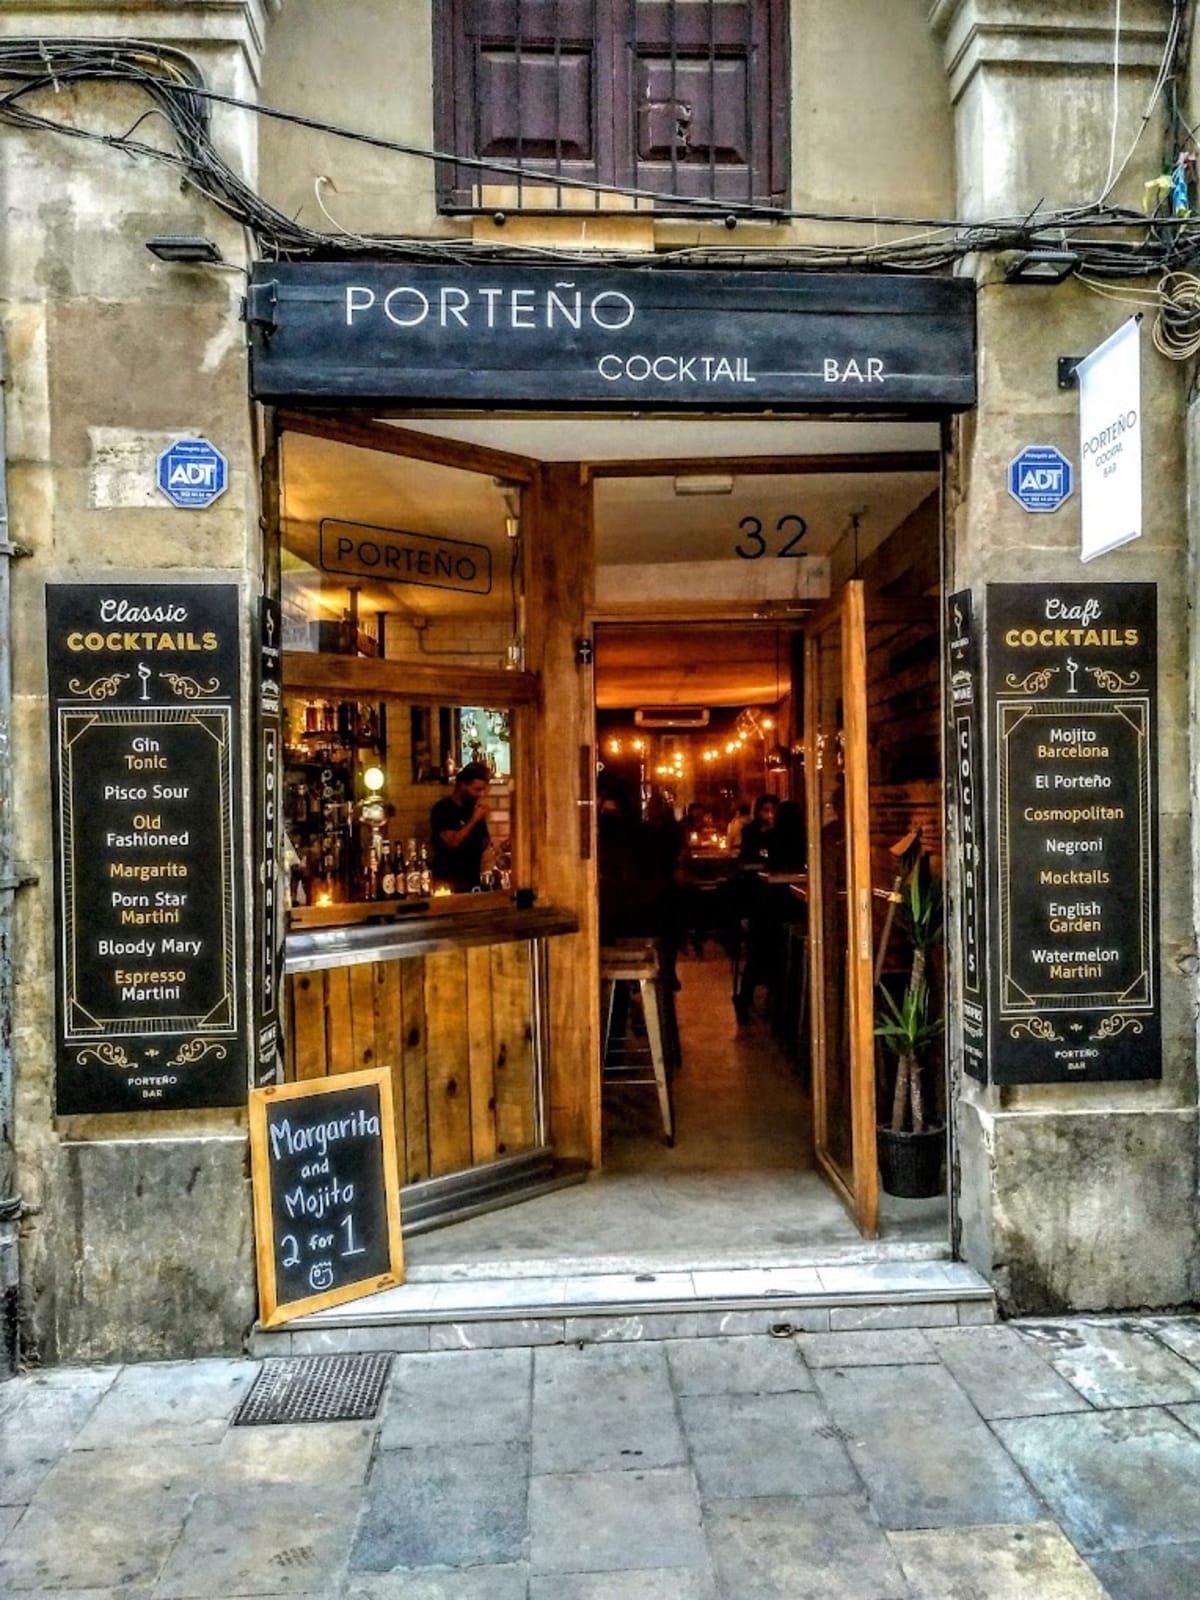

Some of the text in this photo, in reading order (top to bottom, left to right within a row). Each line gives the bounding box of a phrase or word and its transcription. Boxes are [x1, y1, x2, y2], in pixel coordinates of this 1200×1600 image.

[345, 281, 635, 330] PORTEÑO
[597, 355, 885, 383] COCKTAIL BAR
[1082, 410, 1137, 460] PORTEÑO
[169, 462, 216, 486] ADT
[1020, 468, 1062, 490] ADT
[735, 514, 808, 559] 32
[337, 537, 477, 581] PORTEÑO
[100, 599, 188, 623] Classic
[1045, 598, 1102, 627] Craft
[66, 631, 218, 651] COCKTAILS
[1005, 628, 1139, 648] COCKTAILS
[132, 737, 160, 753] Gin
[1050, 729, 1097, 746] Mojito
[1037, 745, 1109, 758] Barcelona
[124, 755, 168, 770] Tonic
[1035, 774, 1111, 789] El Porteño
[104, 784, 189, 800] Pisco Sour
[133, 815, 161, 830] Old
[1024, 806, 1124, 823] Cosmopolitan
[107, 831, 189, 847] Fashioned
[1046, 838, 1103, 855] Negroni
[960, 731, 975, 973] COCKTAILS
[110, 863, 188, 881] Margarita
[265, 743, 274, 994] COCKTAILS
[1040, 870, 1110, 885] Mocktails
[112, 891, 187, 907] Porn Star
[121, 909, 179, 925] Martini
[1049, 902, 1101, 921] English
[1049, 918, 1101, 933] Garden
[98, 938, 202, 957] Bloody Mary
[1032, 949, 1119, 964] Watermelon
[114, 970, 186, 986] Espresso
[1050, 964, 1102, 979] Martini
[121, 986, 180, 1001] Martini
[1054, 1049, 1099, 1059] PORTEÑO
[1067, 1061, 1086, 1070] BAR
[127, 1075, 178, 1086] PORTEÑO
[142, 1089, 163, 1098] BAR
[270, 1109, 381, 1160] Margarita
[301, 1158, 329, 1178] and
[284, 1178, 354, 1219] Mojito
[280, 1214, 366, 1267] 2 for 1
